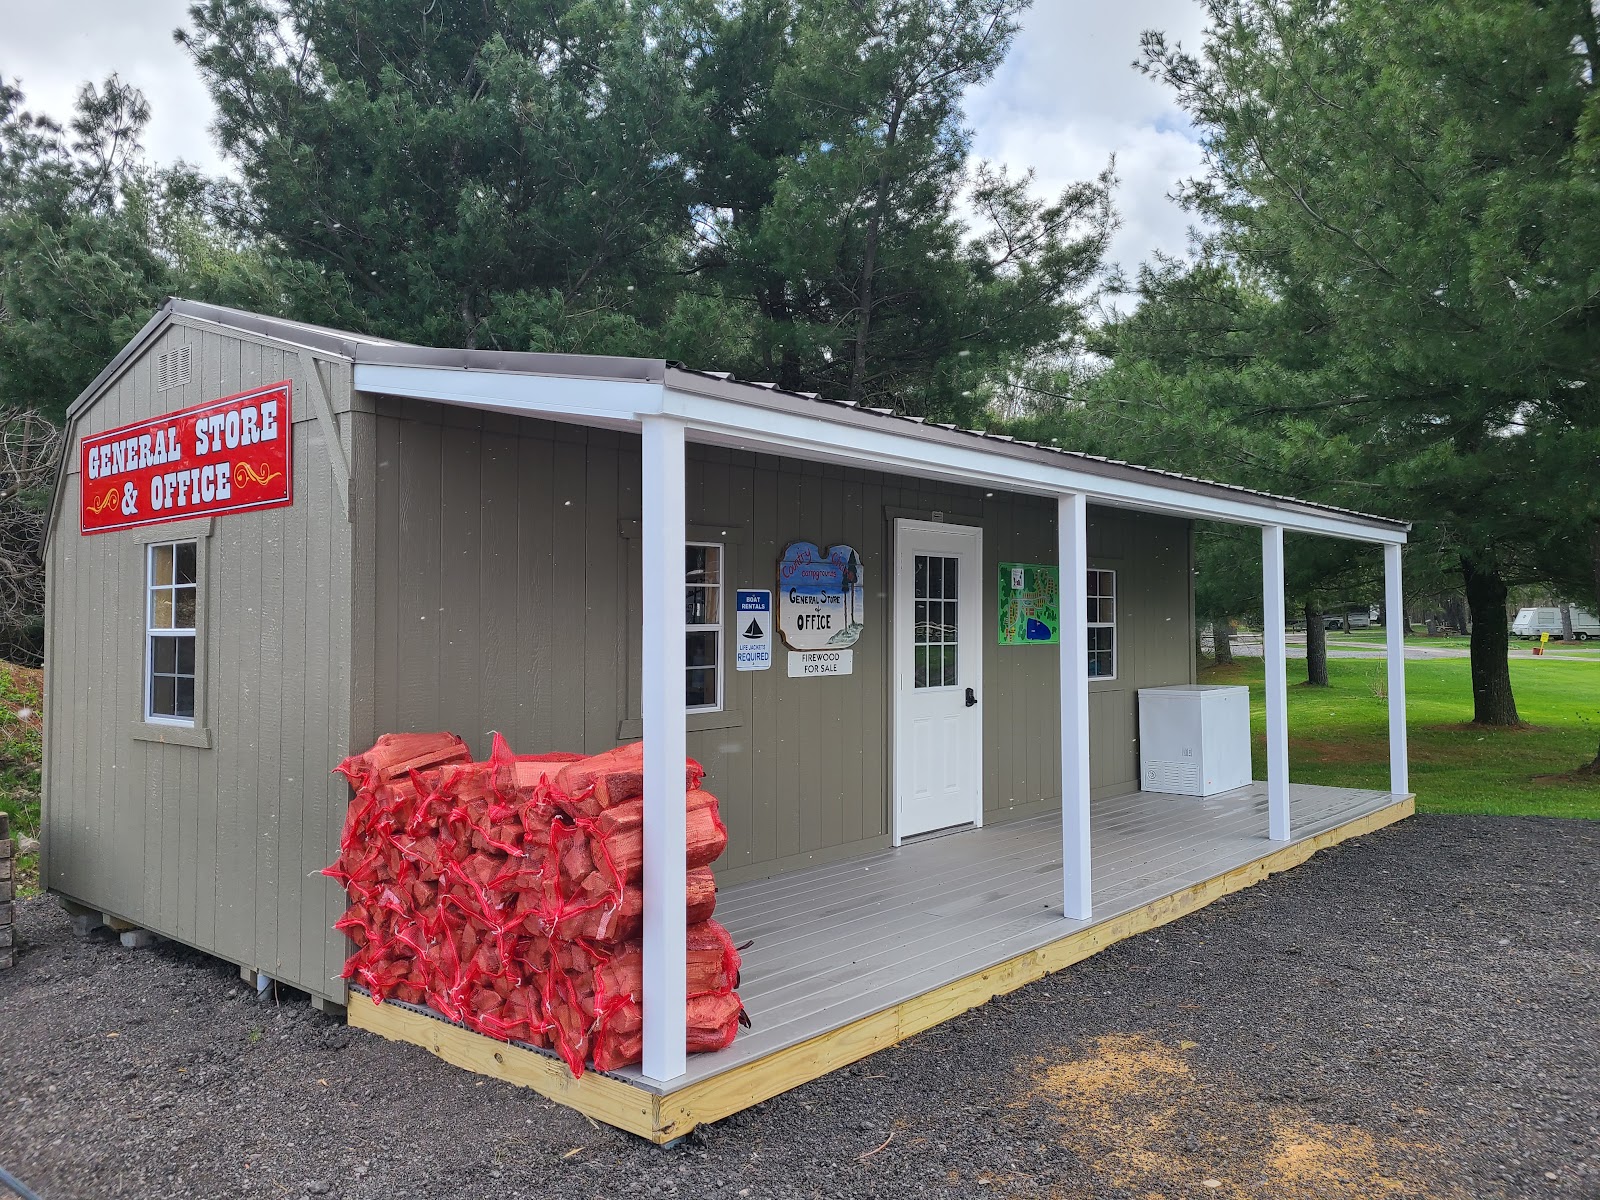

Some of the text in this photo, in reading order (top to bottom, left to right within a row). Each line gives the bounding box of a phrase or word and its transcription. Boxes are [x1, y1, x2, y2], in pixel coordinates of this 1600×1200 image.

[88, 400, 278, 480] GENERAL STORE
[121, 462, 231, 516] & OFFICE
[782, 548, 812, 578] Country
[797, 614, 832, 631] OFFICE
[737, 652, 769, 662] REQUIRED
[802, 653, 840, 663] FIREWOOD
[804, 664, 837, 674] FOR SALE
